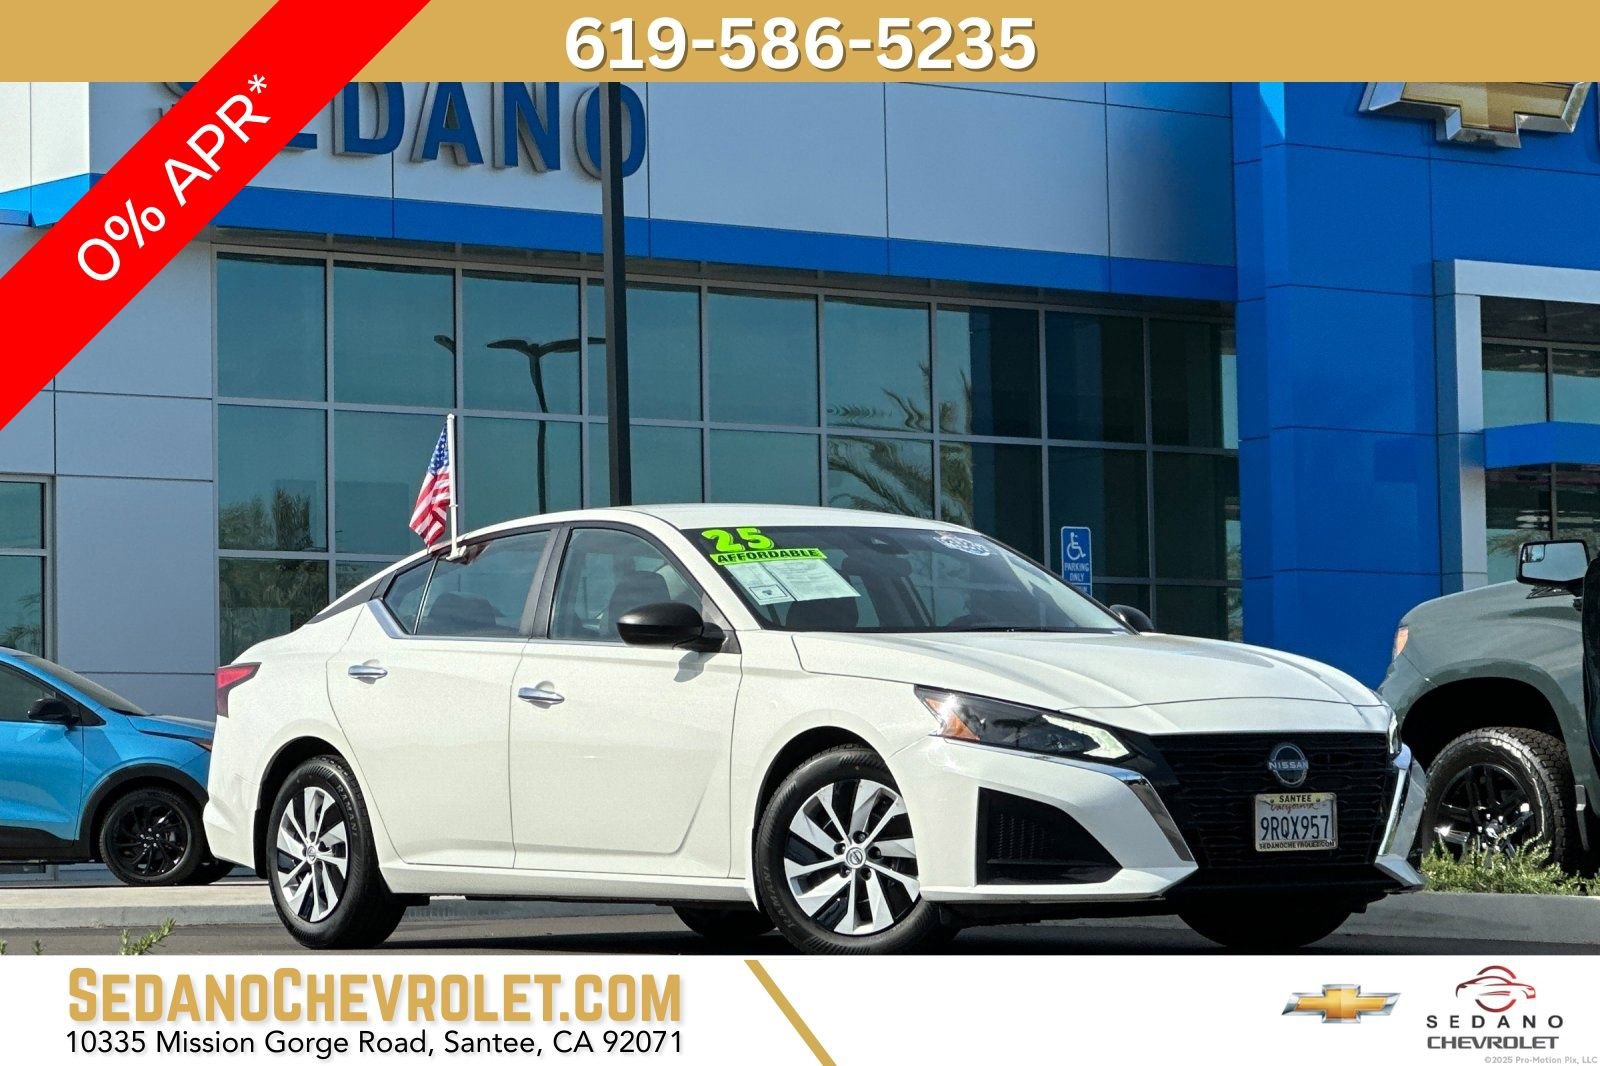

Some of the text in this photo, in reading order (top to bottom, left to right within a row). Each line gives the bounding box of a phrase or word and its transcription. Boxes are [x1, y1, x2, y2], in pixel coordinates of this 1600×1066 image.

[701, 527, 774, 552] 25
[716, 549, 820, 565] AFFORDABLE
[1064, 562, 1090, 572] PARKING
[1069, 572, 1085, 582] ONLY
[1268, 761, 1309, 770] NISSAN
[1279, 794, 1312, 803] SANTEE
[1260, 815, 1329, 841] 9RQX957
